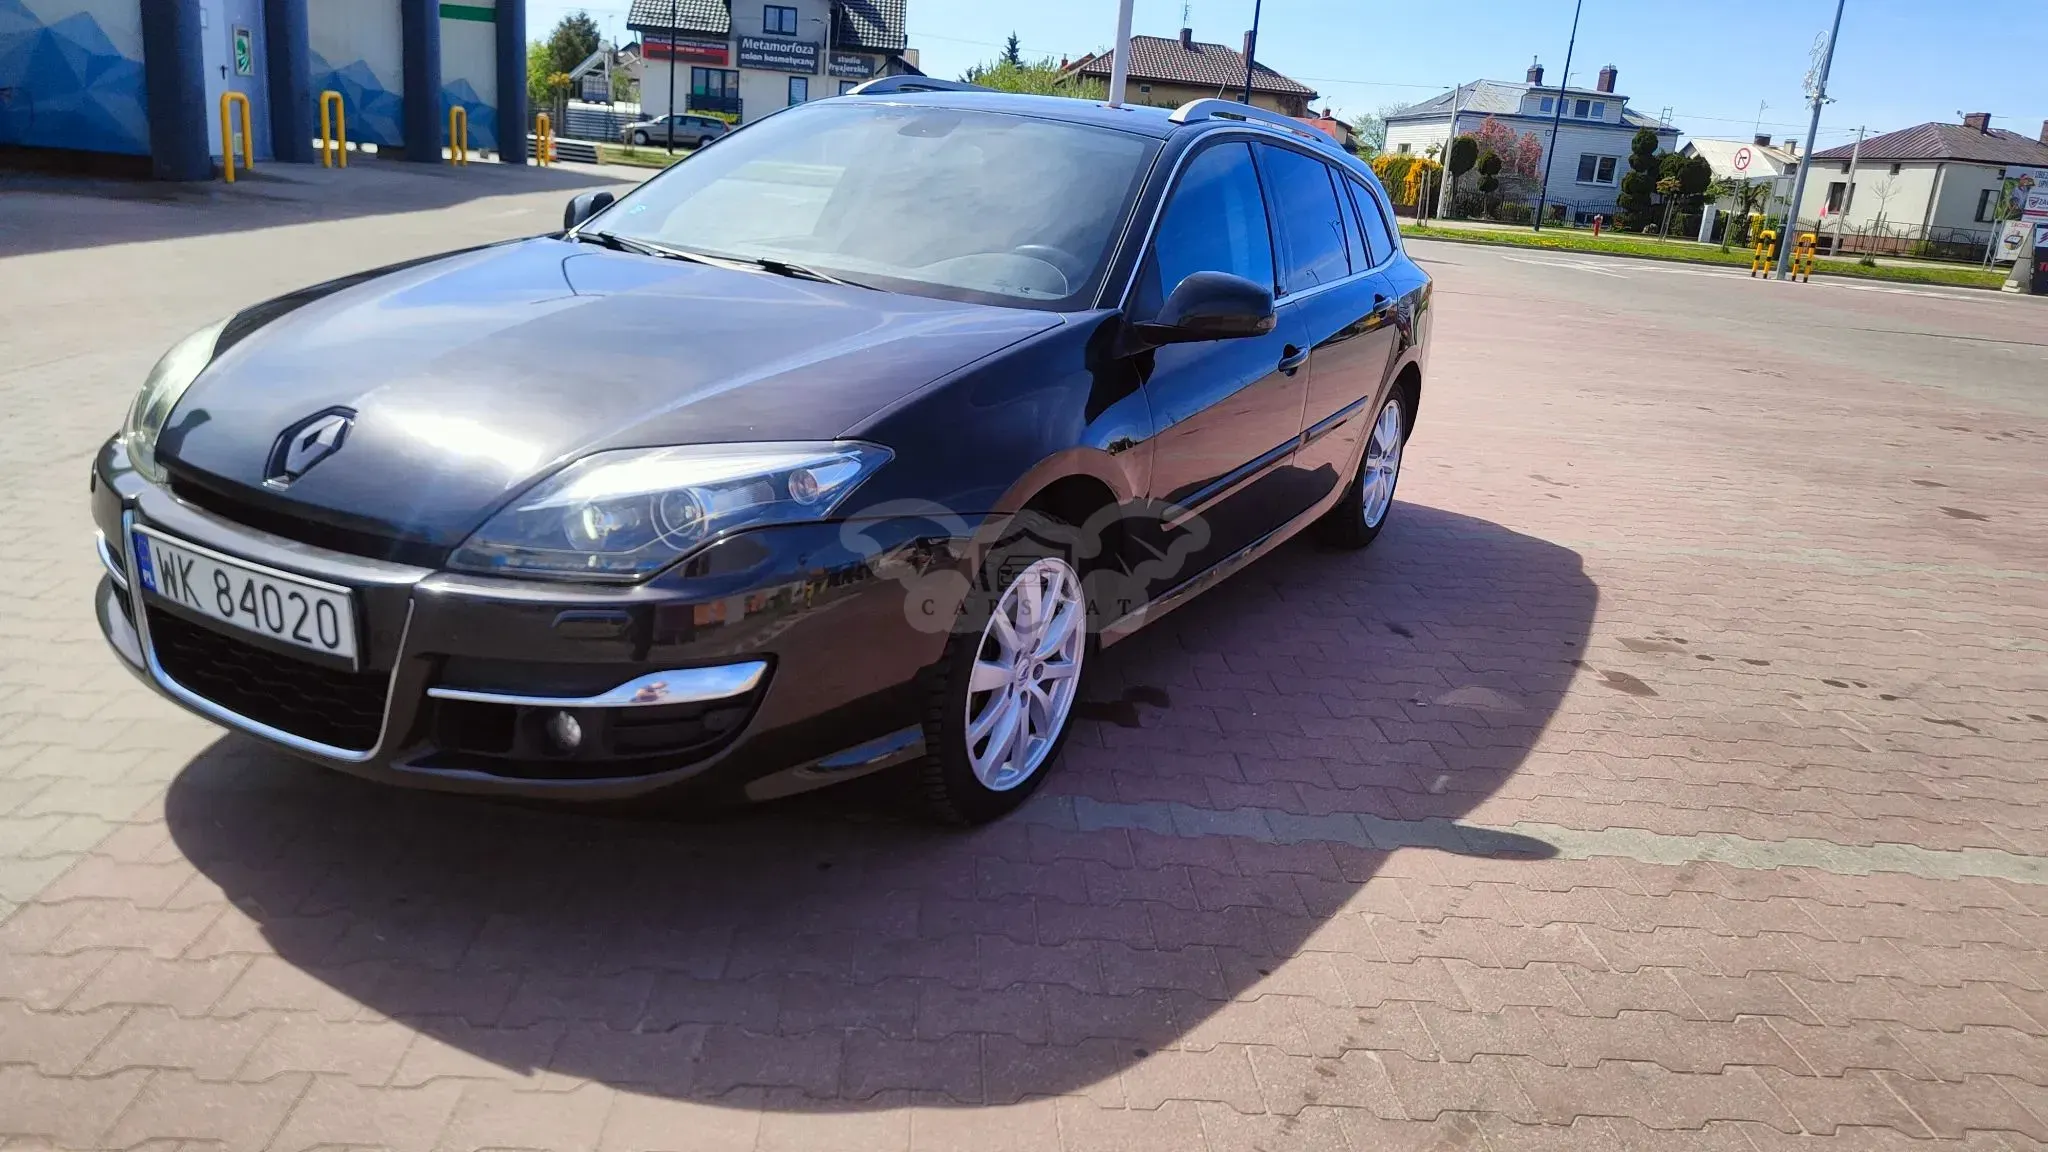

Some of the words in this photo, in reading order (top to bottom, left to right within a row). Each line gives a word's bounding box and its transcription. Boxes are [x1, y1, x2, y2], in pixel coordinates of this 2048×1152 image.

[742, 38, 814, 54] Metamorfoza
[741, 52, 762, 60] salon
[764, 53, 815, 68] kosmetyczny
[838, 56, 861, 64] studio
[156, 546, 203, 609] WK
[213, 569, 341, 649] 84020
